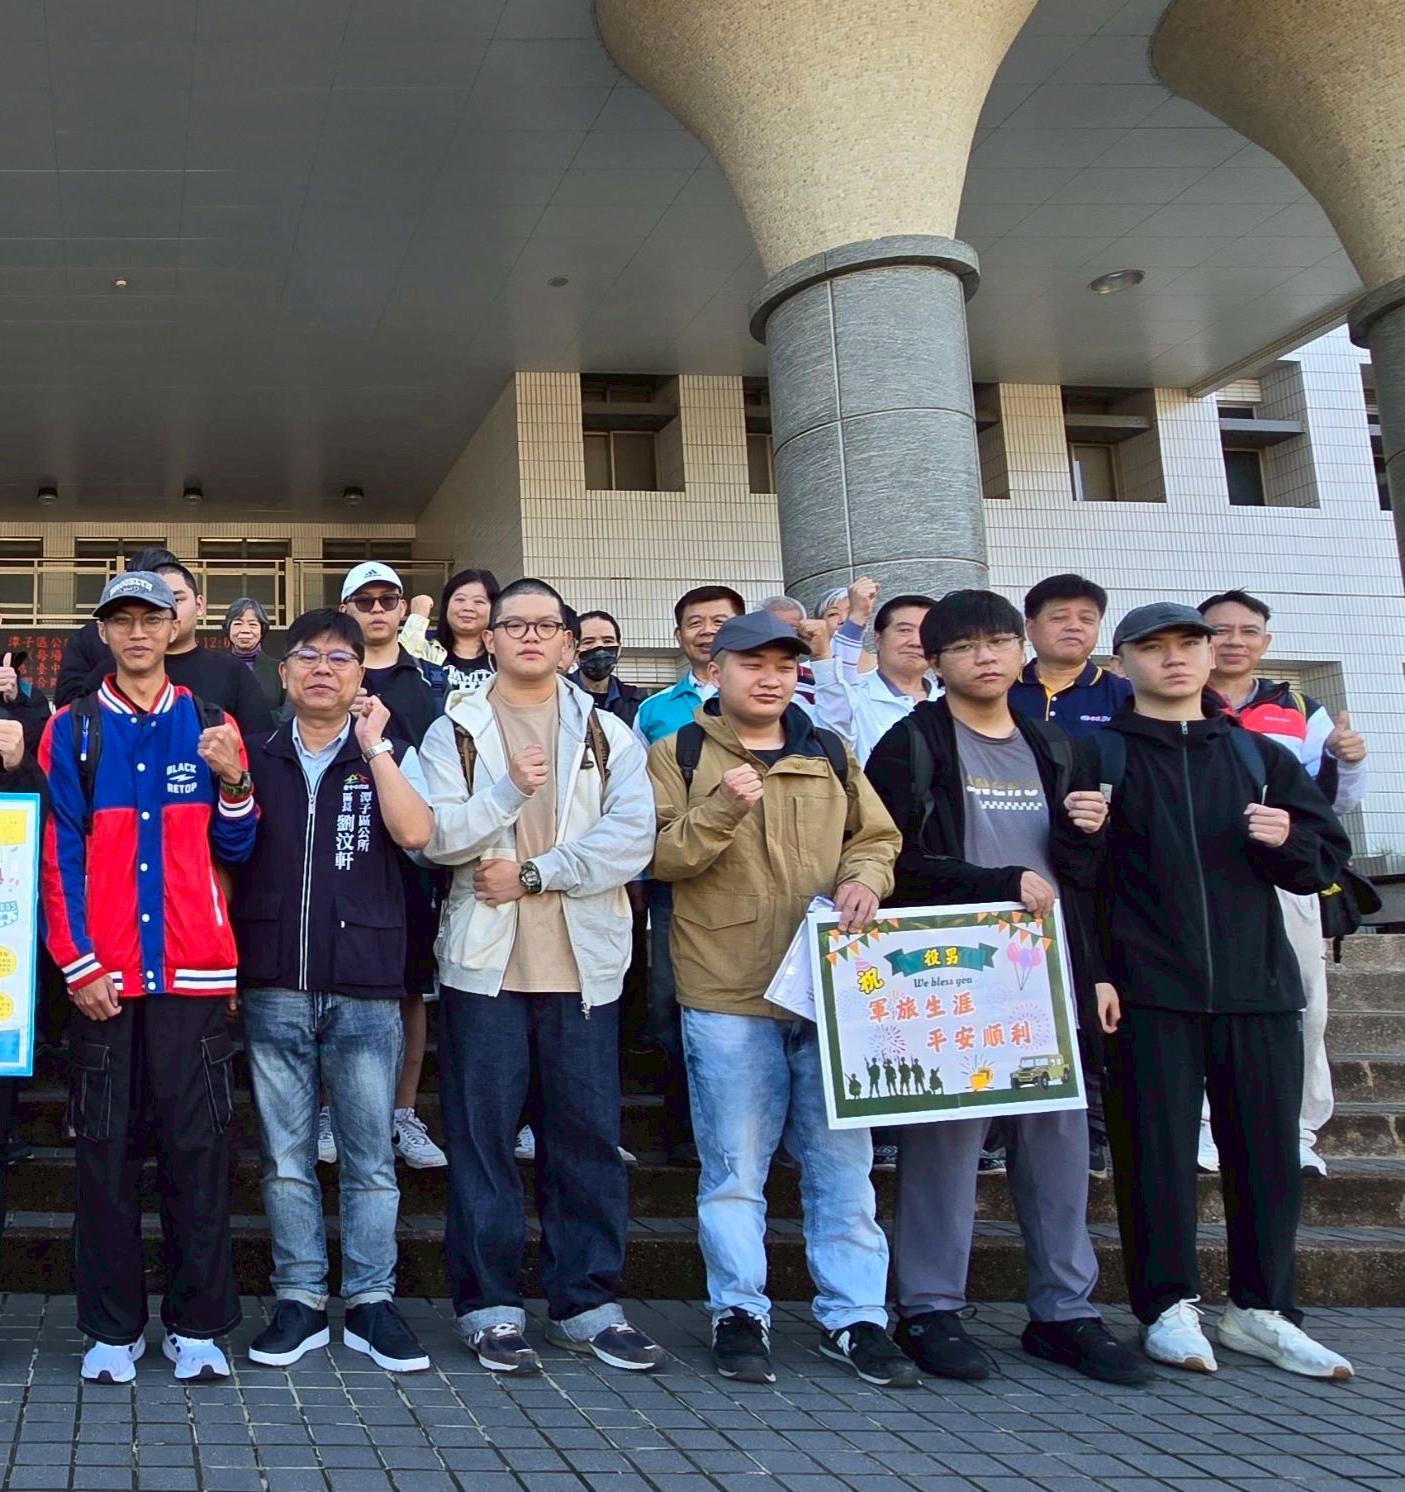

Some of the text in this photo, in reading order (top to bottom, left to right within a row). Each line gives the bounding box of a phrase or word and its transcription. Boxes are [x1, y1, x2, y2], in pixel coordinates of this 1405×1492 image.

[7, 635, 68, 648] 潭子區公
[166, 763, 197, 776] BLACK
[167, 782, 197, 794] RETOP
[335, 791, 355, 871] 區長 劉汶軒
[358, 791, 373, 853] 潭子區公所
[923, 947, 960, 967] 役男
[857, 966, 886, 996] 祝
[913, 976, 973, 987] We bless you
[868, 991, 975, 1023] 軍旅生涯
[926, 1020, 1033, 1052] 平安順利
